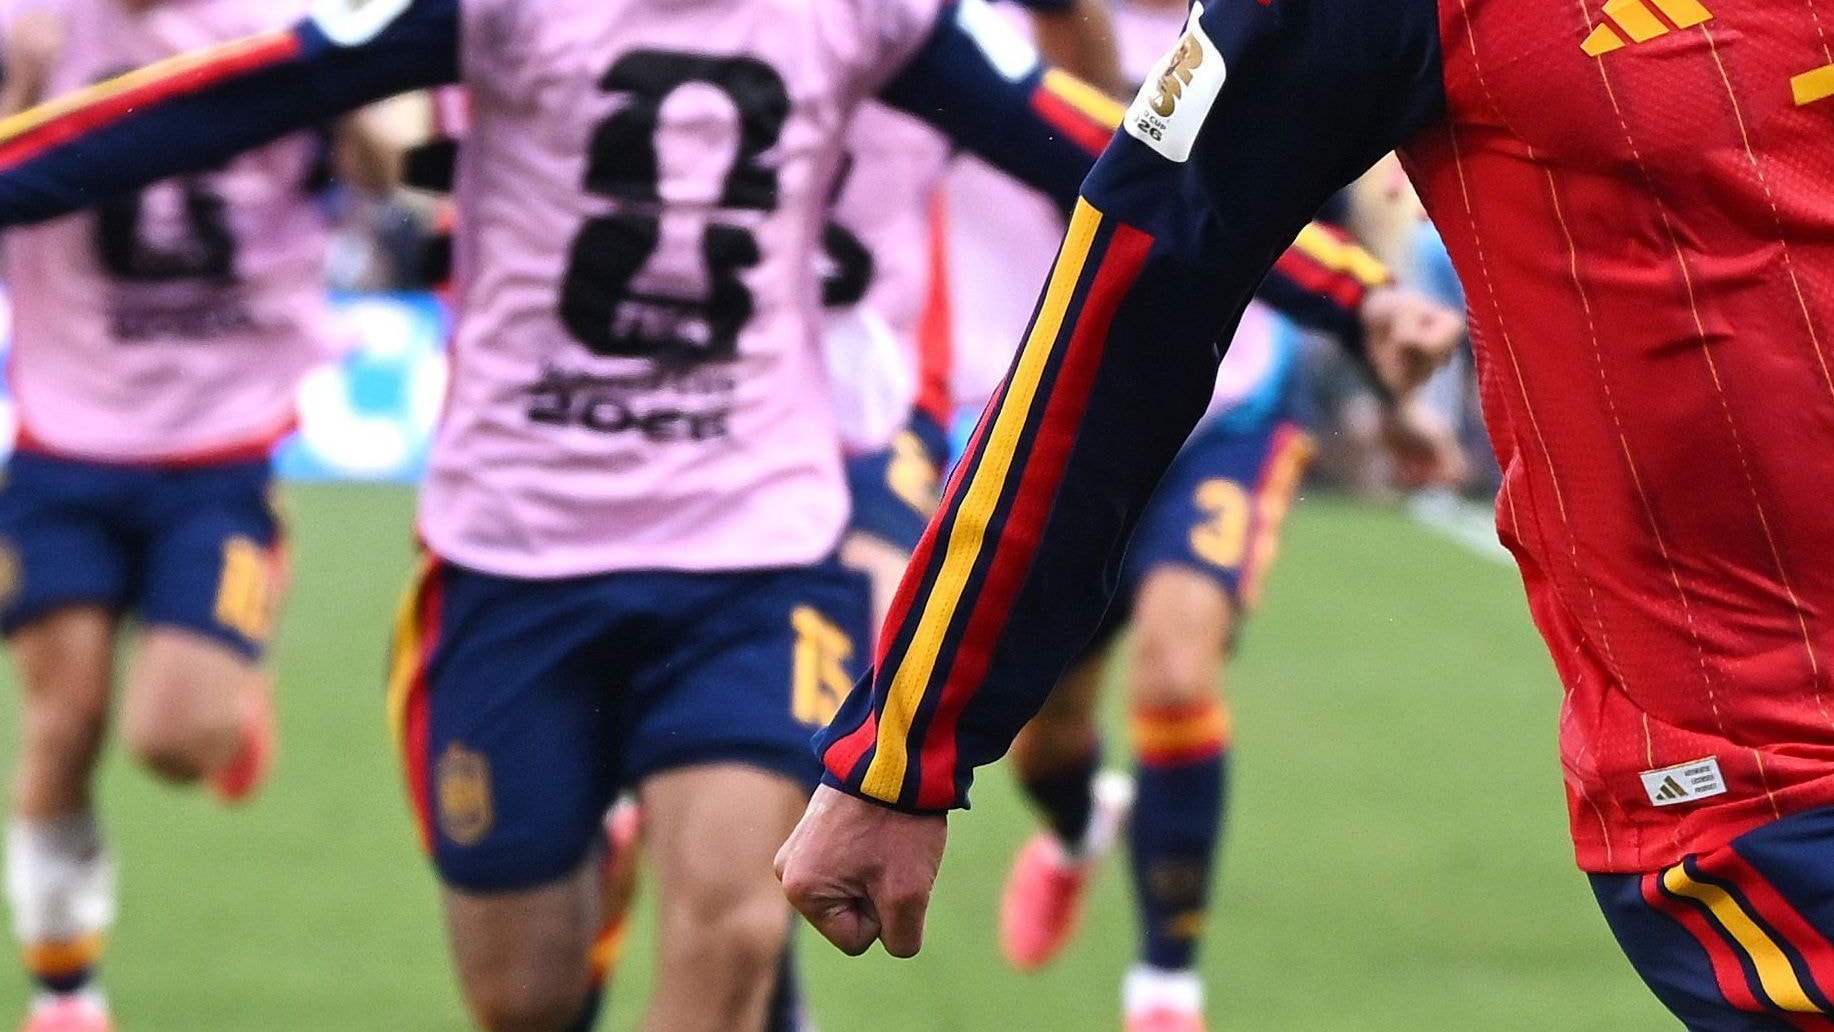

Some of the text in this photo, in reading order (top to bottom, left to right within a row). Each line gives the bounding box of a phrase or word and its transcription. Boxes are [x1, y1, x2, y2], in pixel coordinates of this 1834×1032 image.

[1137, 118, 1163, 142] 26
[1188, 478, 1250, 569] 3
[790, 604, 857, 727] 15
